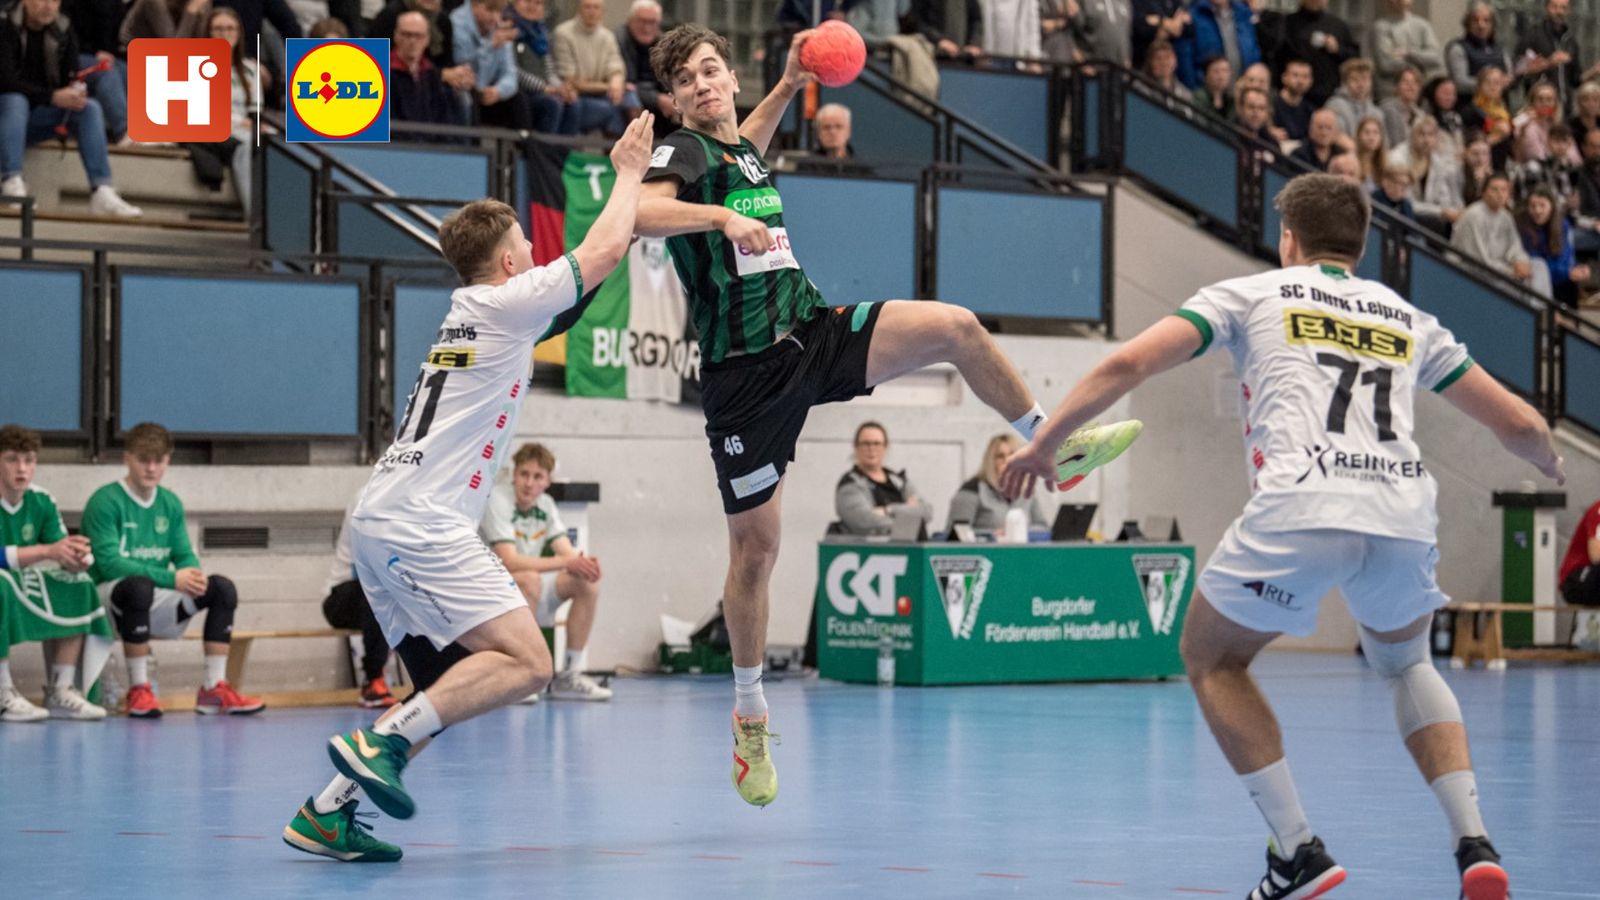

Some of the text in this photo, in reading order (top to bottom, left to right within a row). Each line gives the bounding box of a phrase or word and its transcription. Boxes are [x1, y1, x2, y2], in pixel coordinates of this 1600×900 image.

[1280, 284, 1304, 299] SC
[1356, 299, 1412, 330] Leipzig
[1316, 352, 1398, 442] 71
[724, 434, 744, 456] 46
[1032, 596, 1096, 620] Burgdorfer
[1063, 620, 1117, 641] Handball
